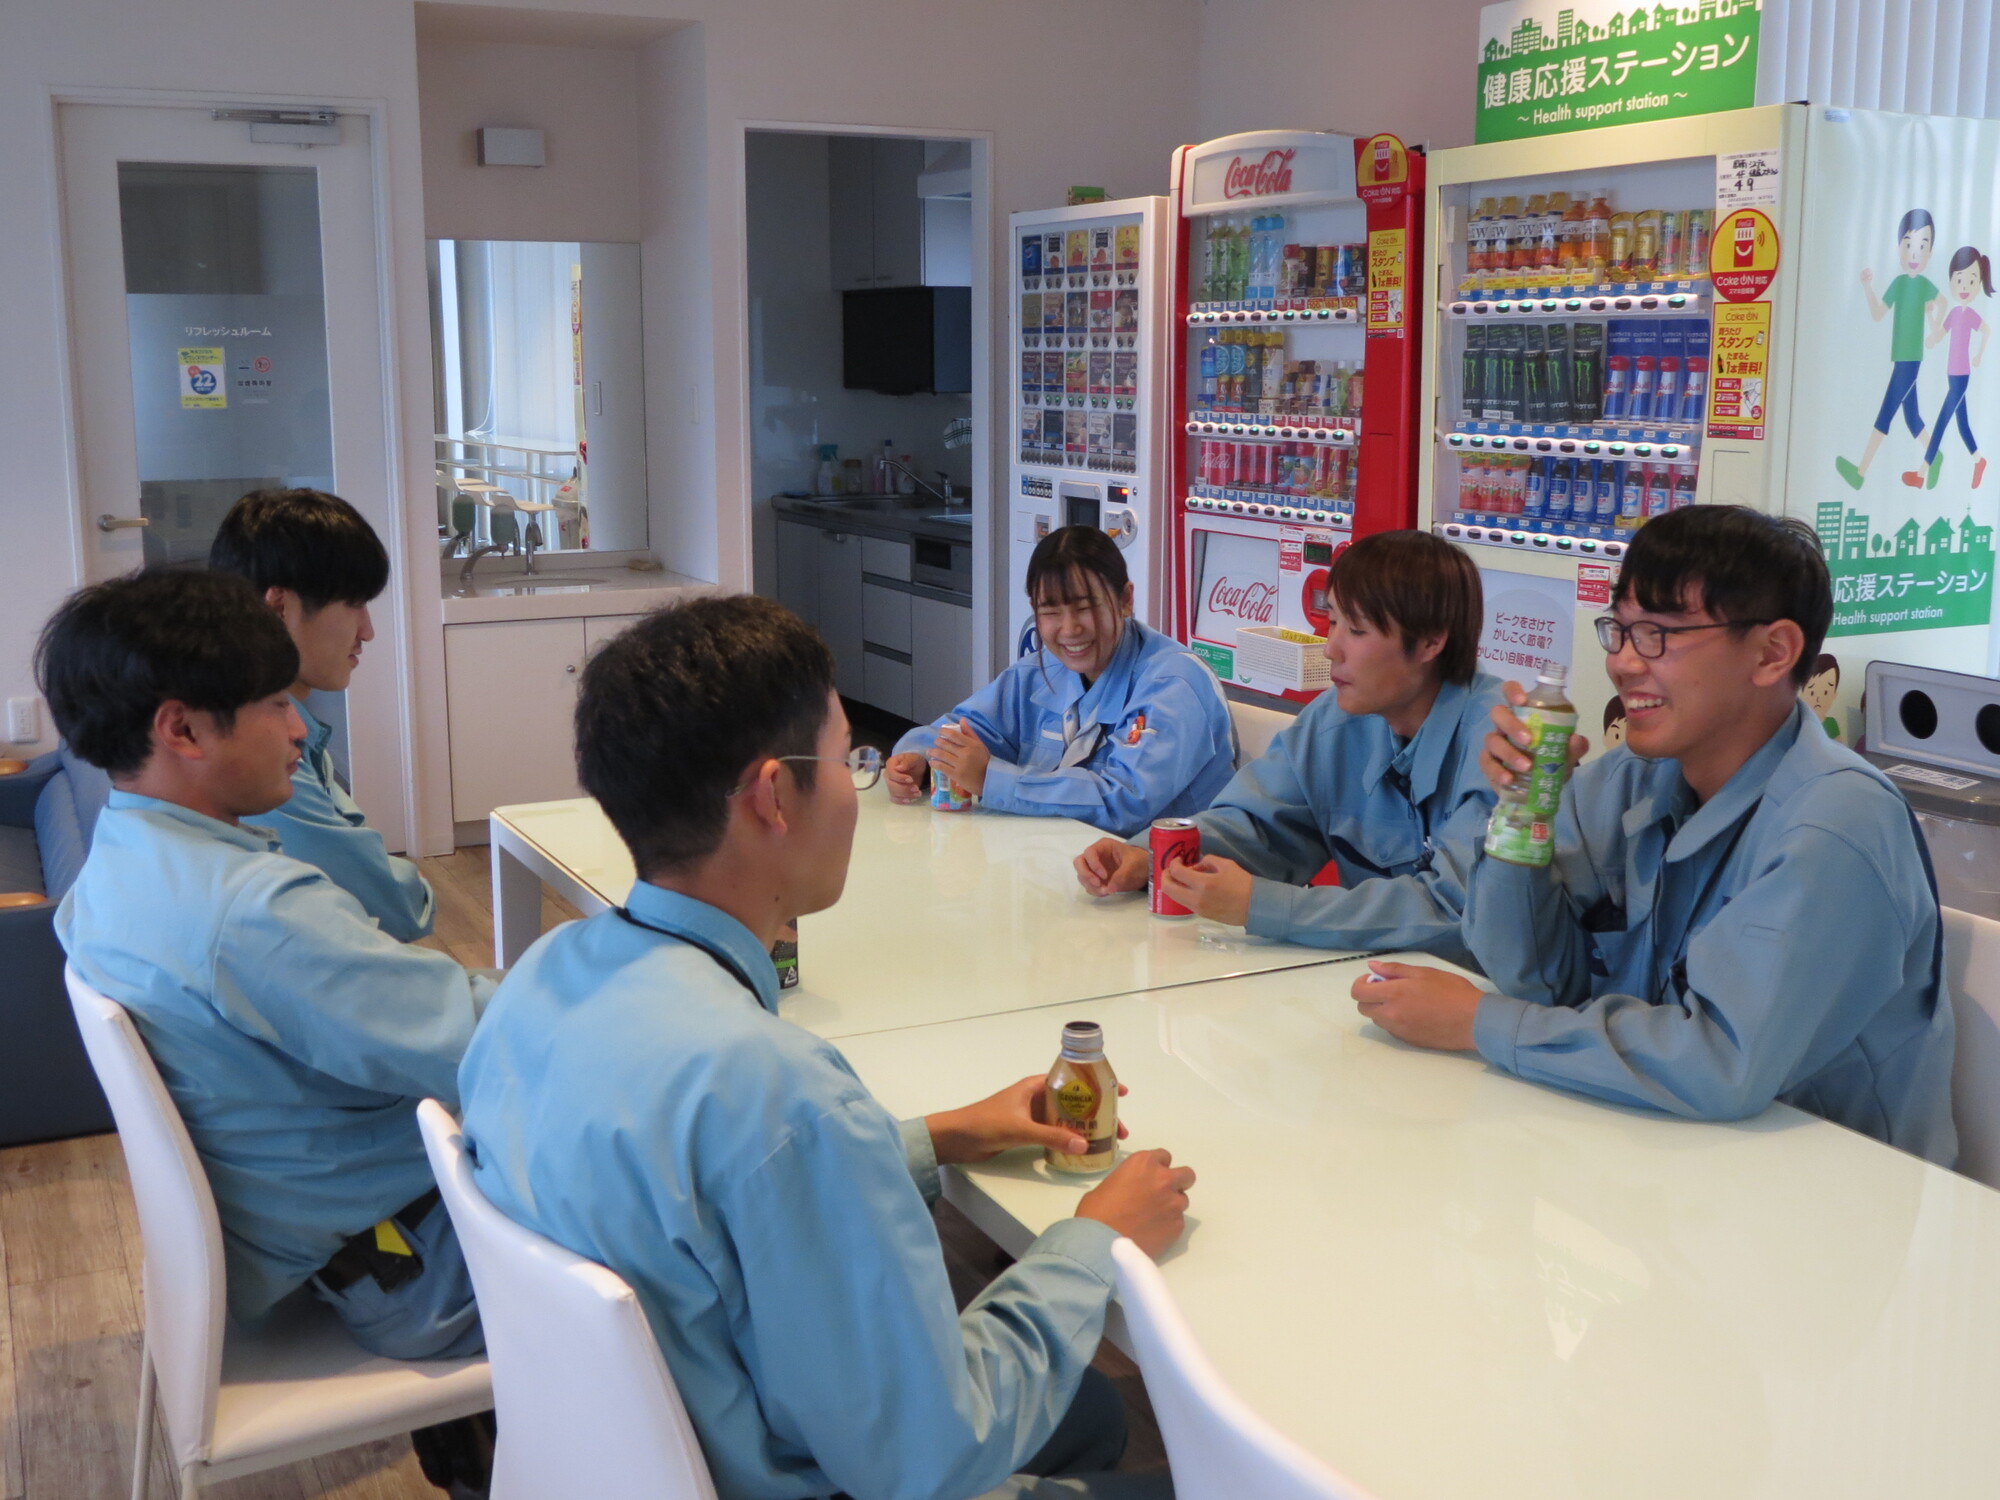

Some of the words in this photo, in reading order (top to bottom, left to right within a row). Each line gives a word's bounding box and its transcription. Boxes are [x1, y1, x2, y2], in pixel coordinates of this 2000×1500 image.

[1483, 34, 1750, 109] 健康応援ステーション
[1534, 102, 1571, 125] Health
[1575, 98, 1622, 122] support
[1626, 91, 1668, 110] station
[1224, 148, 1296, 199] Coca-Cola
[1372, 256, 1396, 267] スタンプ
[1717, 276, 1739, 286] Coke
[1726, 313, 1744, 321] Coke
[185, 326, 272, 336] リフレッシュルーム
[1717, 337, 1754, 348] スタンプ
[1726, 362, 1762, 375] 1本無料!
[194, 374, 215, 387] 22
[1208, 576, 1278, 622] Coca-Cola
[1496, 612, 1556, 633] ピークをさけて
[1833, 609, 1866, 626] Health
[1870, 609, 1908, 625] support
[1911, 605, 1943, 620] station
[1493, 628, 1553, 649] かしこく節電?
